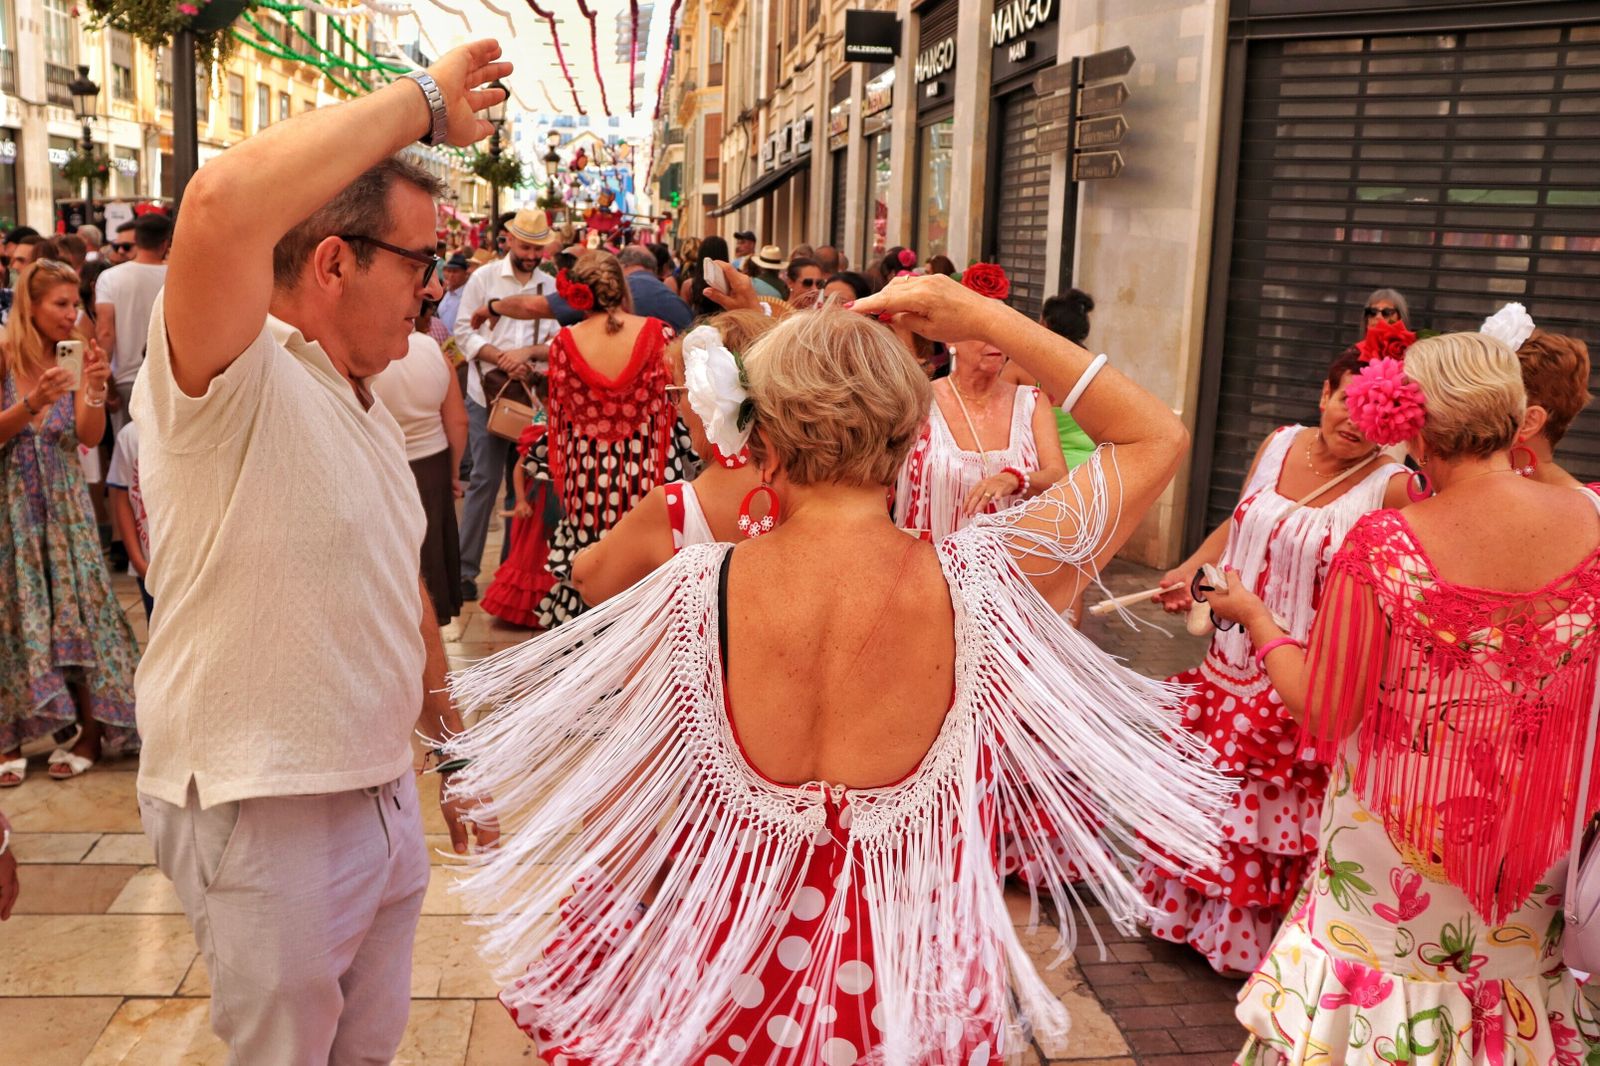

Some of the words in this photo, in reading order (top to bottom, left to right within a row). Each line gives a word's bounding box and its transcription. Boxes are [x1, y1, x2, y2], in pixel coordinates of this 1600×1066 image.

[990, 0, 1052, 48] MANGO
[847, 44, 892, 54] CALZEDONIA
[914, 37, 955, 84] MANGO
[1008, 40, 1027, 63] MAN
[926, 81, 939, 97] MAN
